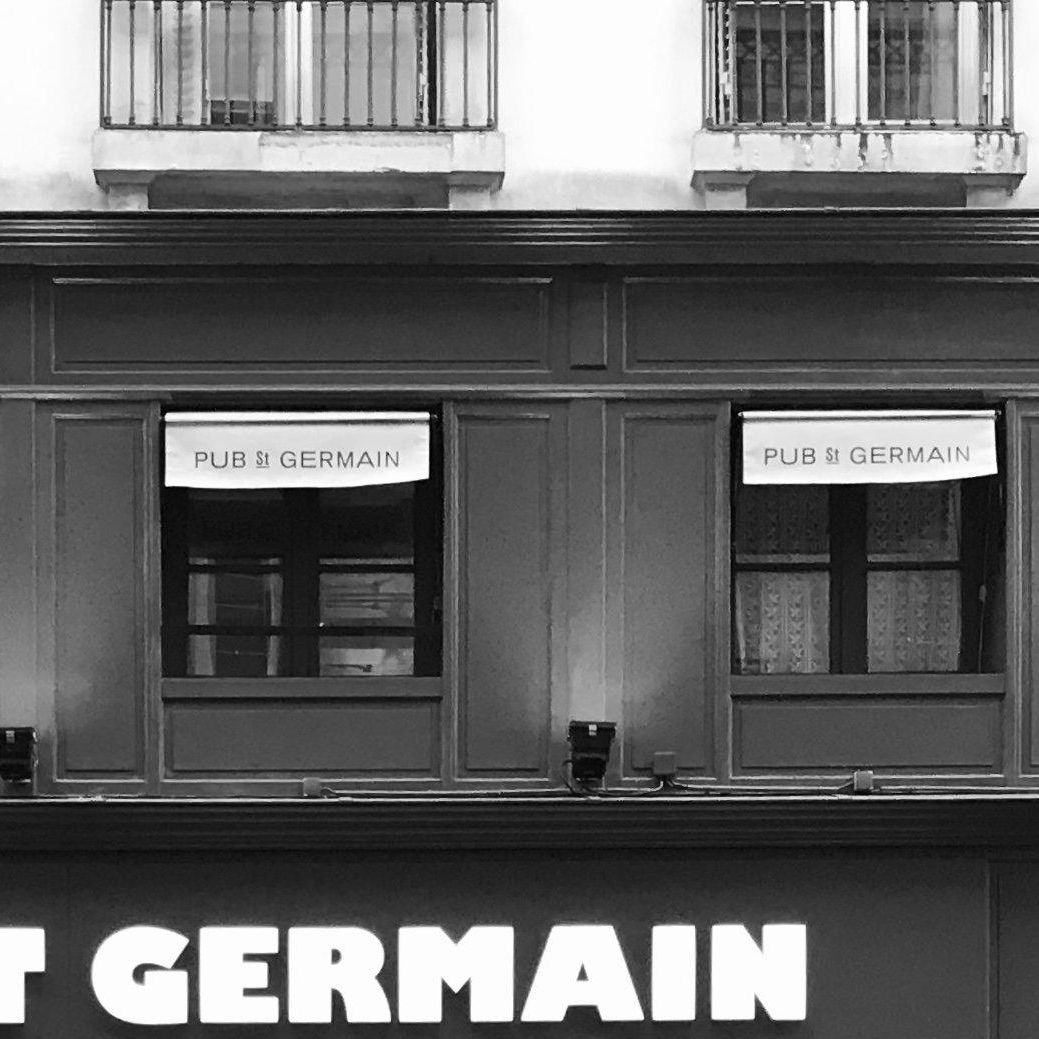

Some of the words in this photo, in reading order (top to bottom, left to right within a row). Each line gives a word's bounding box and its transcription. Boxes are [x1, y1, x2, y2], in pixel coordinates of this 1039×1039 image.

[194, 450, 247, 469] PUB
[279, 450, 401, 469] GERMAIN
[764, 447, 817, 466] PUB
[849, 446, 971, 465] GERMAIN
[90, 923, 809, 1026] GERMAIN
